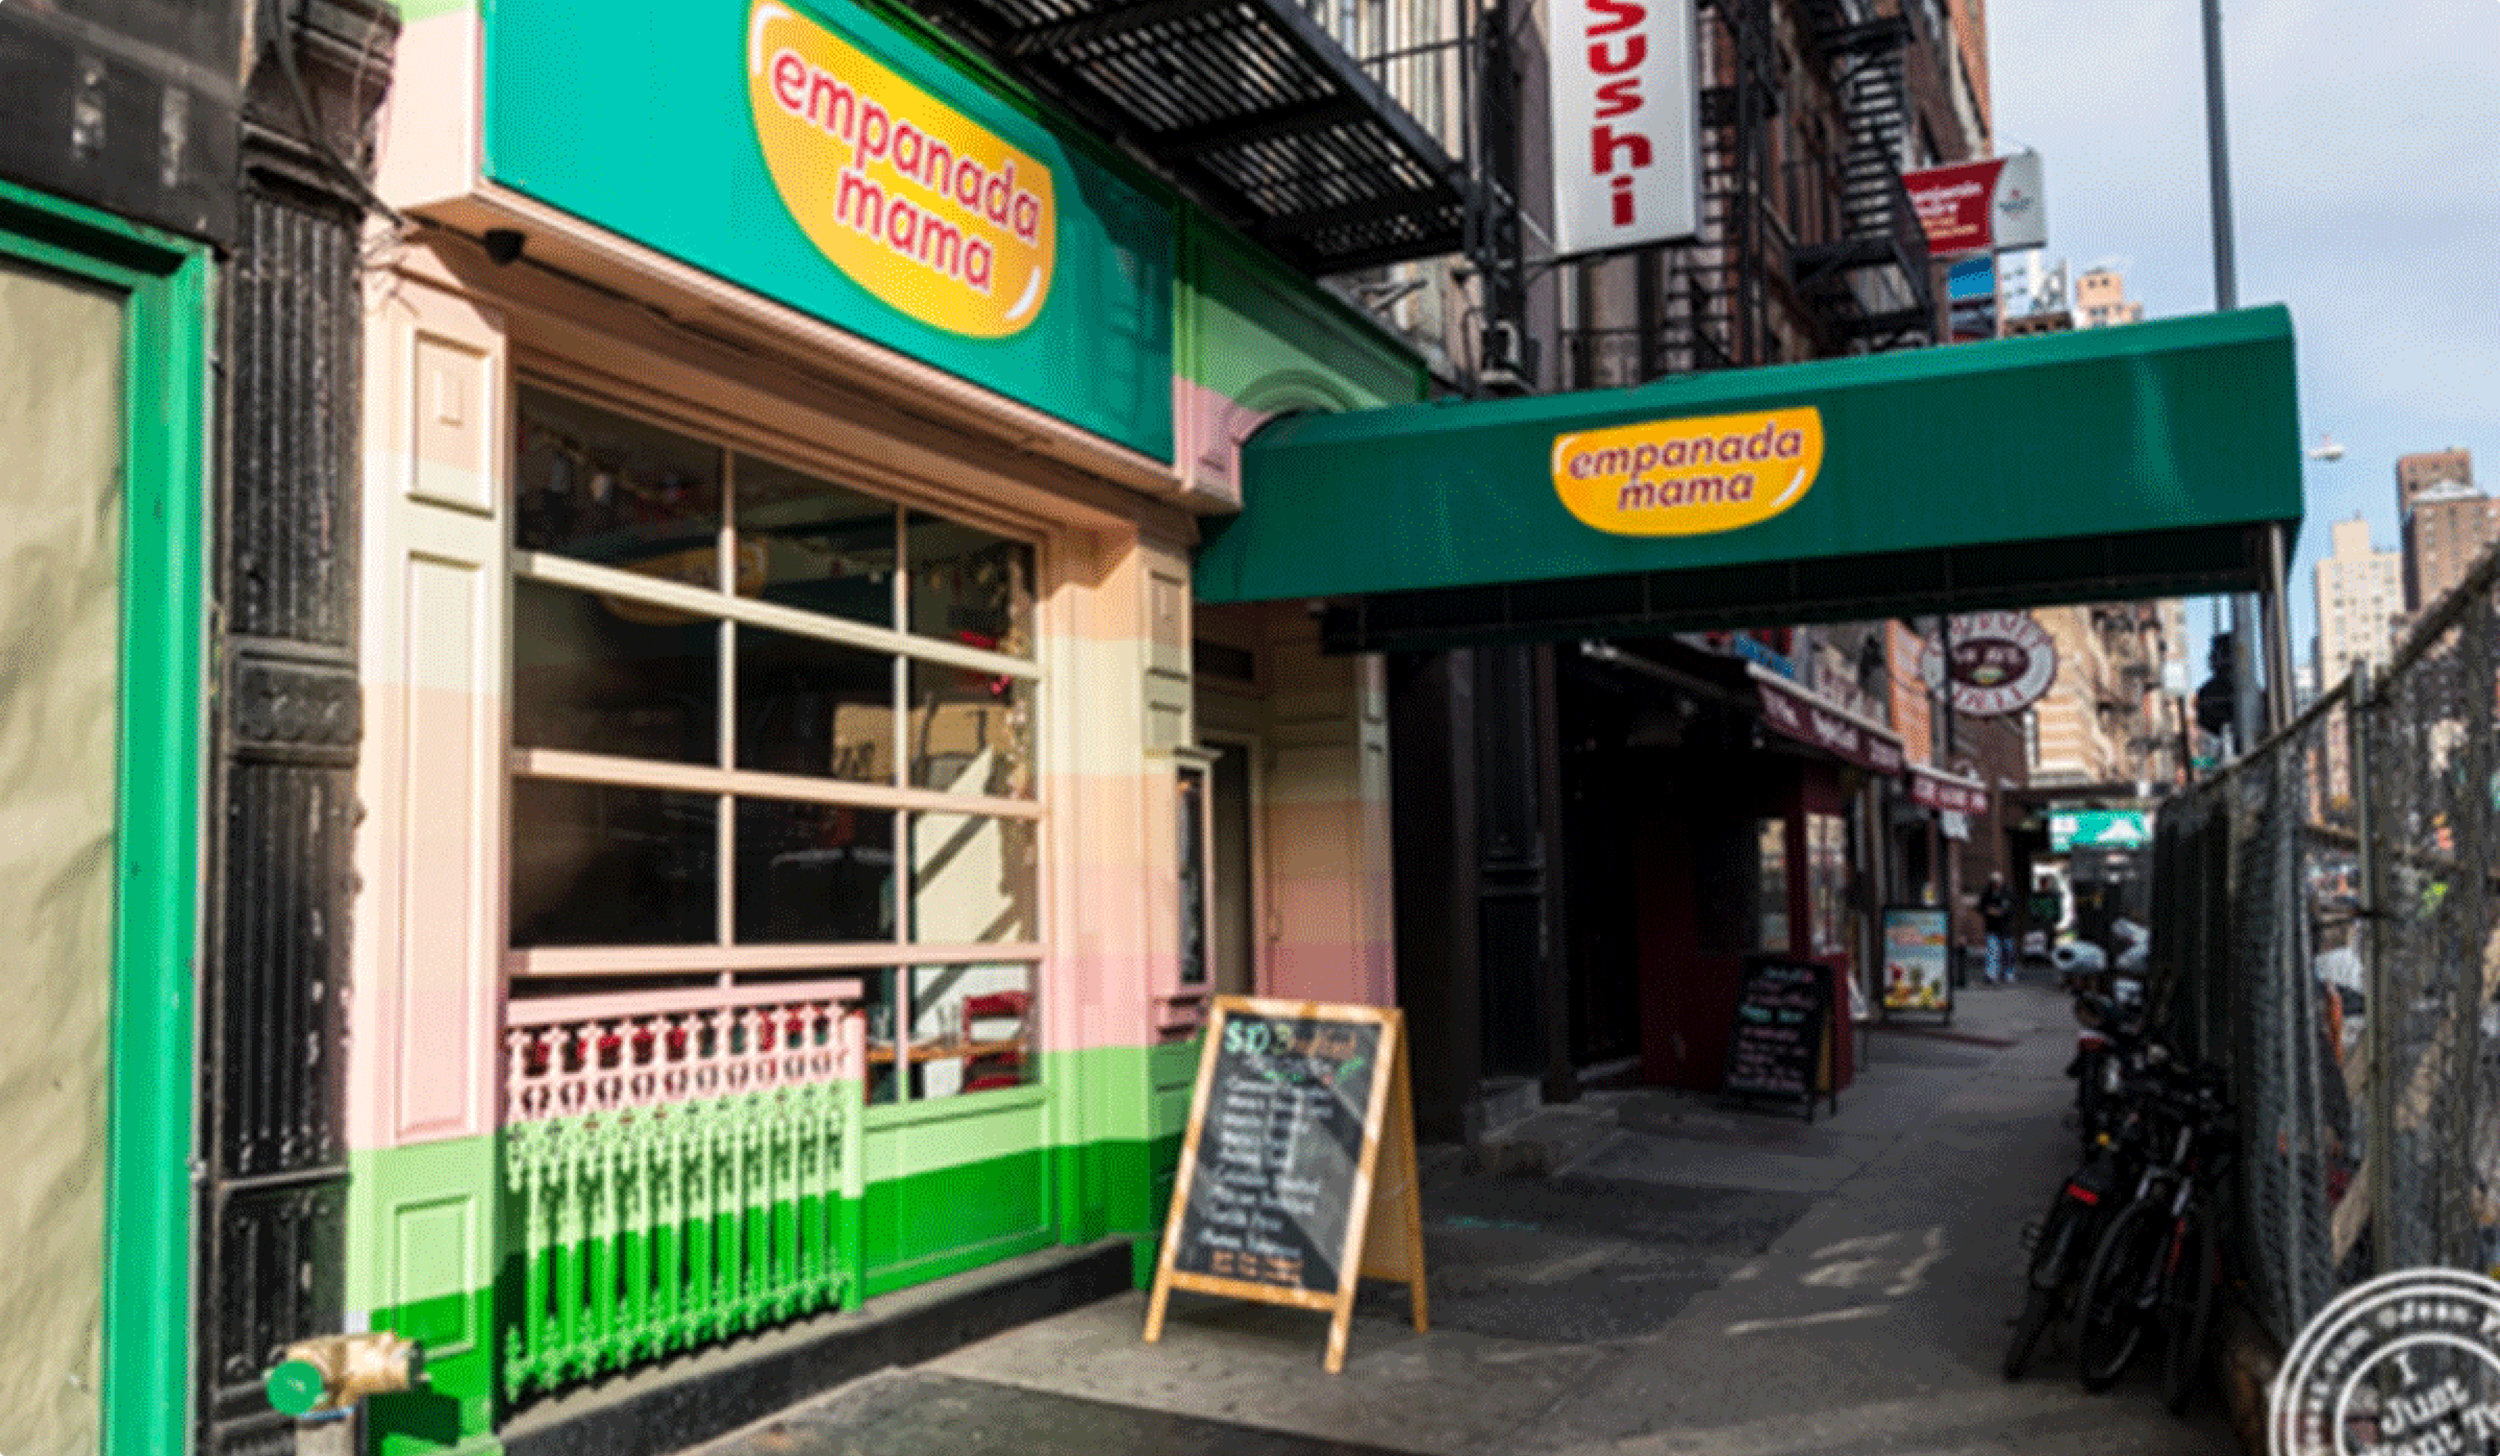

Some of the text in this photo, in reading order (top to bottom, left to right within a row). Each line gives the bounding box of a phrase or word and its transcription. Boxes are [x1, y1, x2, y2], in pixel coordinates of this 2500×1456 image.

[771, 49, 1041, 248] empanada
[833, 166, 994, 295] mama
[1568, 418, 1805, 483] empanada
[1616, 472, 1756, 512] mama
